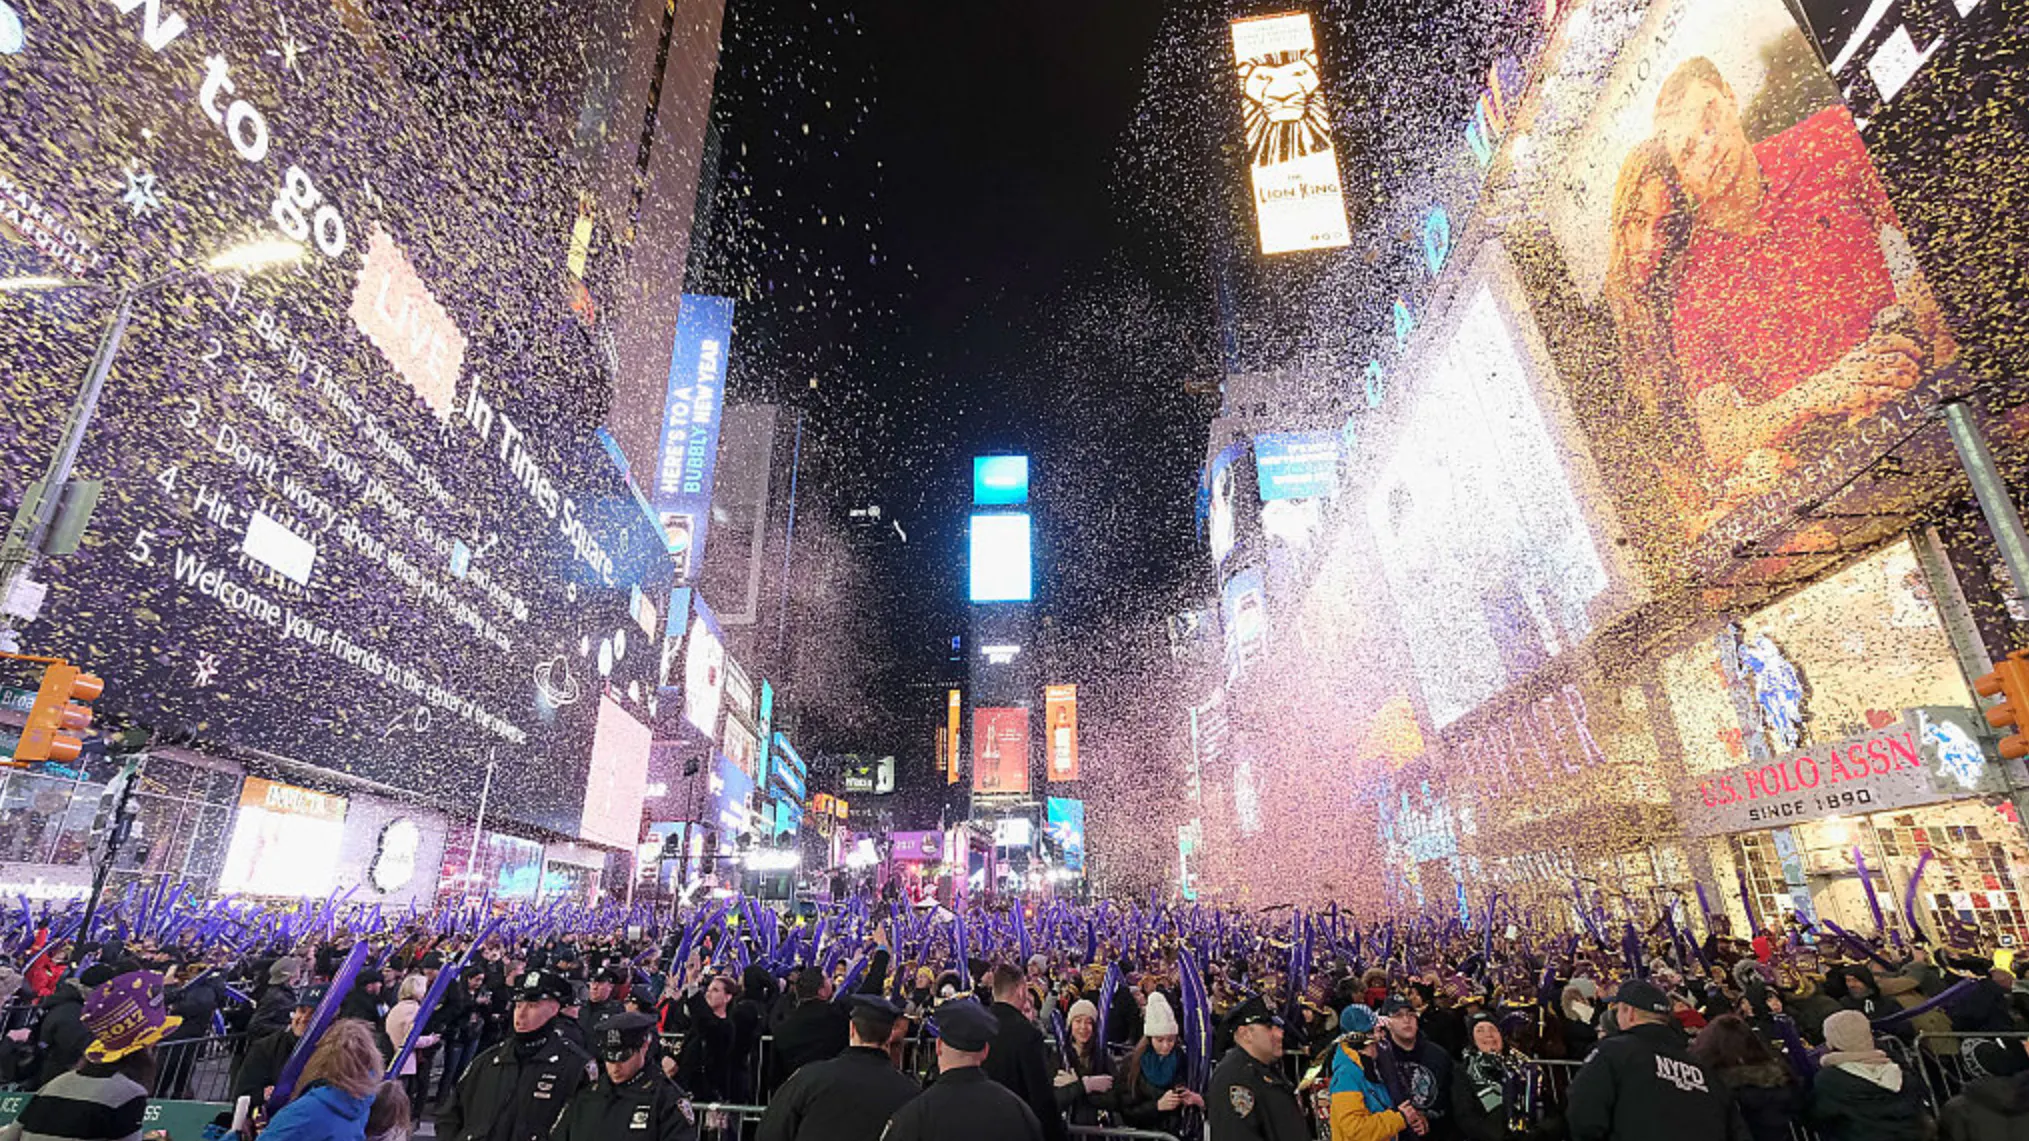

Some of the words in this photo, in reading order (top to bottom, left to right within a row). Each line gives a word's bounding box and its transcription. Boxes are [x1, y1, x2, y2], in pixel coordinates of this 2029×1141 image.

[200, 53, 269, 162] to
[271, 164, 346, 258] go
[1259, 187, 1295, 205] LION
[1299, 182, 1338, 200] KING
[0, 175, 102, 268] MARRIOTT
[257, 309, 287, 350] Be
[288, 345, 308, 375] in
[310, 361, 362, 425] Times
[697, 338, 720, 383] YEAR
[671, 401, 691, 427] TO
[674, 386, 693, 401] A
[692, 385, 714, 423] NEW
[238, 365, 285, 421] Take
[289, 417, 321, 452] out
[322, 446, 364, 485] your
[415, 515, 434, 544] Go
[434, 532, 449, 556] to
[464, 375, 494, 441] in
[499, 411, 559, 519] Times
[560, 498, 617, 588] Square
[660, 428, 686, 494] HERE'S
[683, 425, 708, 494] BUBBLY
[194, 484, 234, 530] Hit
[215, 423, 279, 488] Don't
[282, 475, 339, 532] worry
[338, 516, 386, 563] about
[386, 548, 420, 588] what
[455, 601, 485, 638] going
[174, 547, 283, 627] Welcome
[281, 608, 327, 647] your
[328, 628, 383, 675] friends
[384, 660, 400, 683] to
[403, 668, 425, 697] the
[426, 686, 461, 712] center
[2, 688, 34, 710] Broa
[1700, 776, 1745, 809] U.S.
[1746, 755, 1821, 799] POLO
[1831, 732, 1920, 786] ASSN
[1749, 801, 1806, 822] SINCE
[1817, 788, 1873, 812] 1890
[97, 1008, 146, 1043] 2017
[1655, 1053, 1705, 1085] NYPD
[143, 1105, 163, 1122] SS
